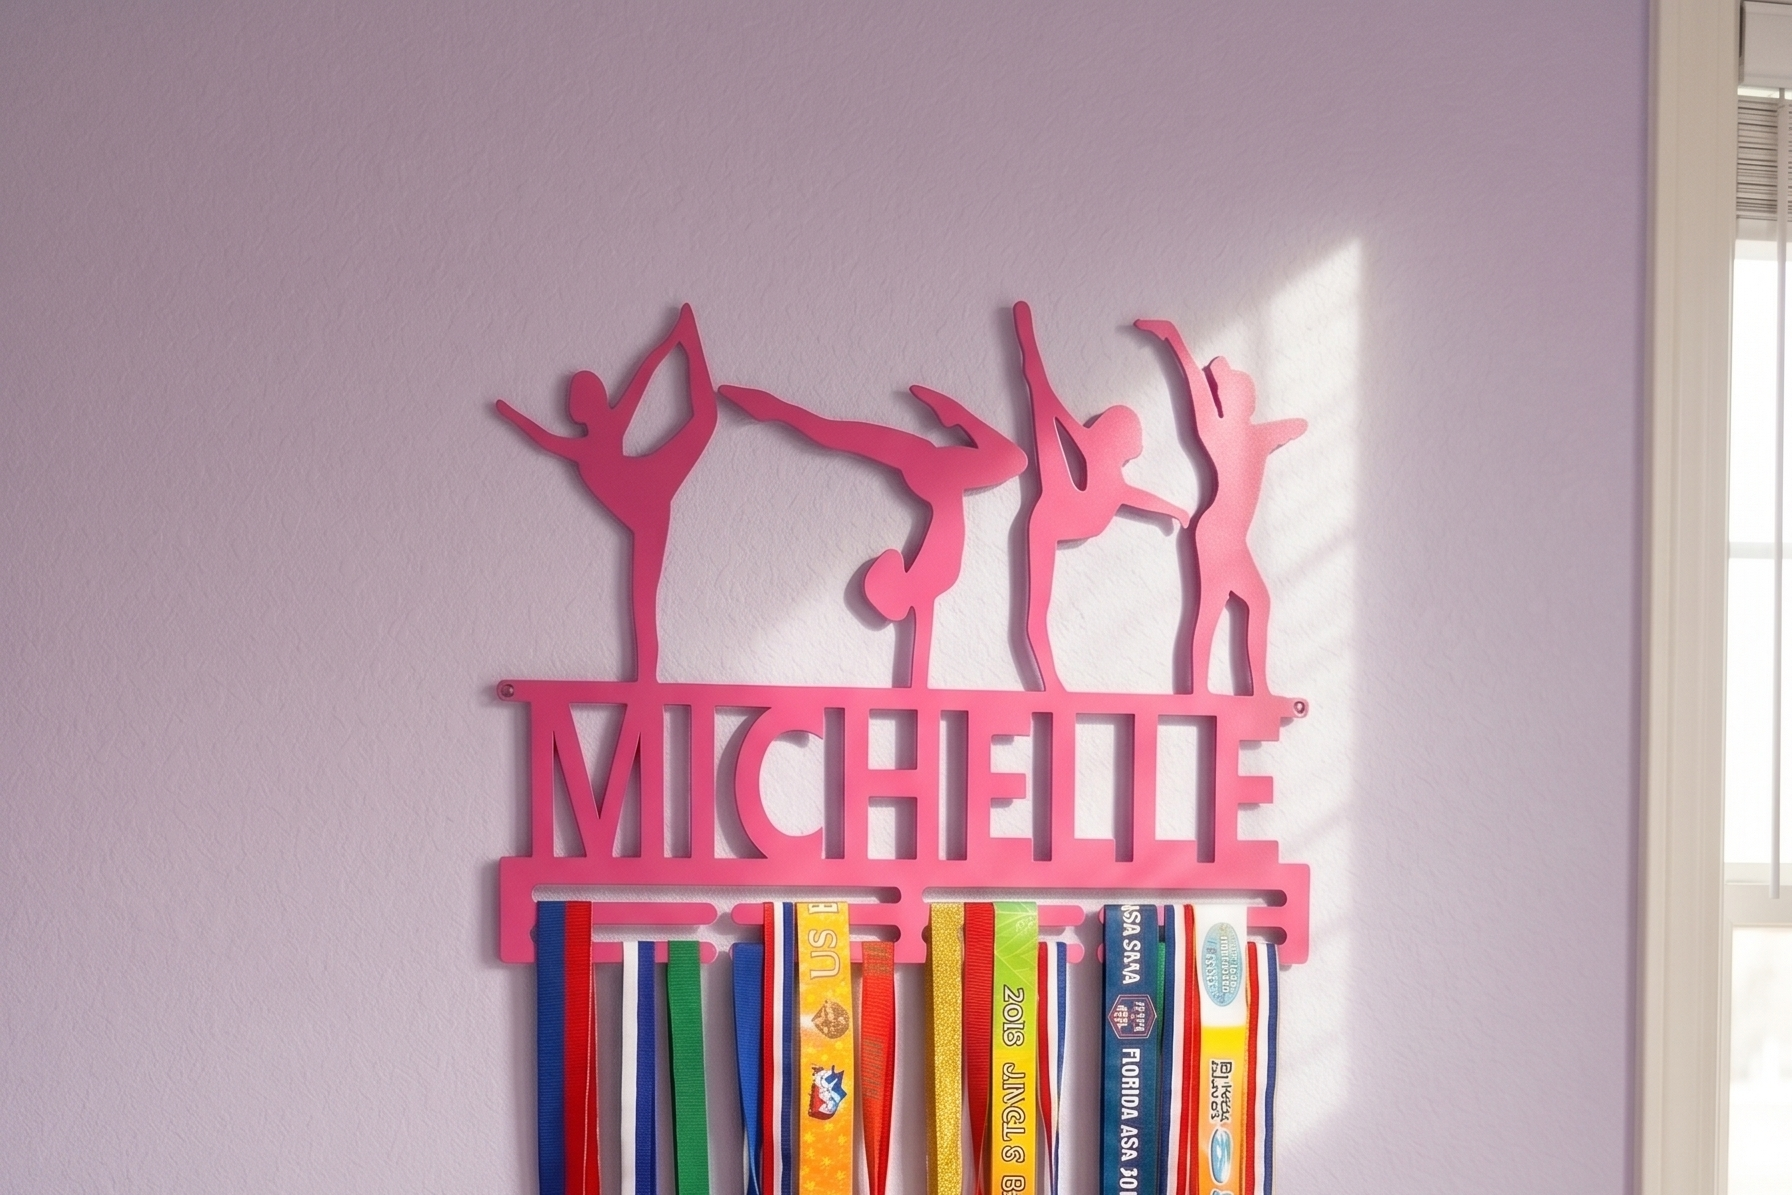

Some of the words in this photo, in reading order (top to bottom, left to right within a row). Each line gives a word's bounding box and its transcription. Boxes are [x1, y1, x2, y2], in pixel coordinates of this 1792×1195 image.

[530, 692, 1279, 862] MICHELLE
[1120, 1047, 1141, 1120] FLORIDA
[1119, 1124, 1139, 1162] ASA
